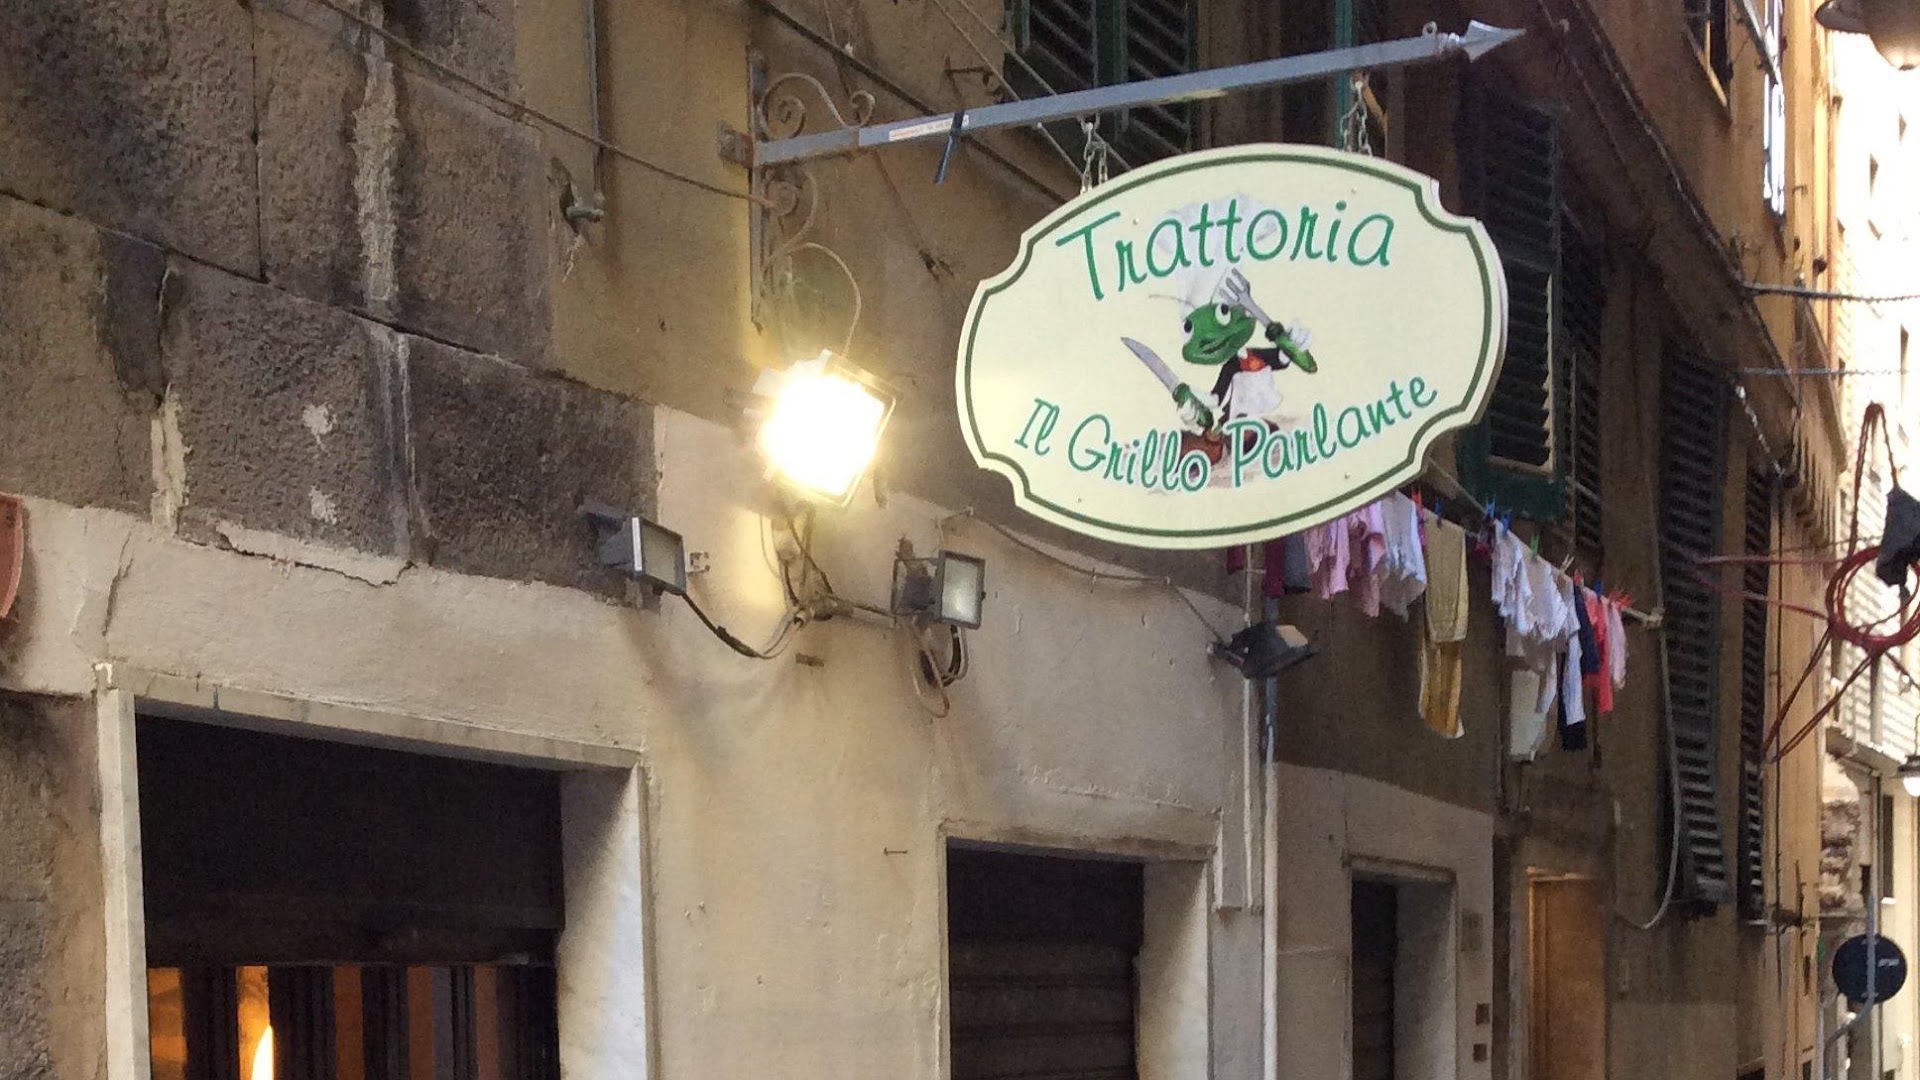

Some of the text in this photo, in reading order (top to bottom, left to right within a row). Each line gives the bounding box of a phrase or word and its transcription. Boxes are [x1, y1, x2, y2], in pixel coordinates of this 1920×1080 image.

[1056, 200, 1395, 300] Trattoria
[1015, 377, 1438, 491] Il Grillo Parlante
